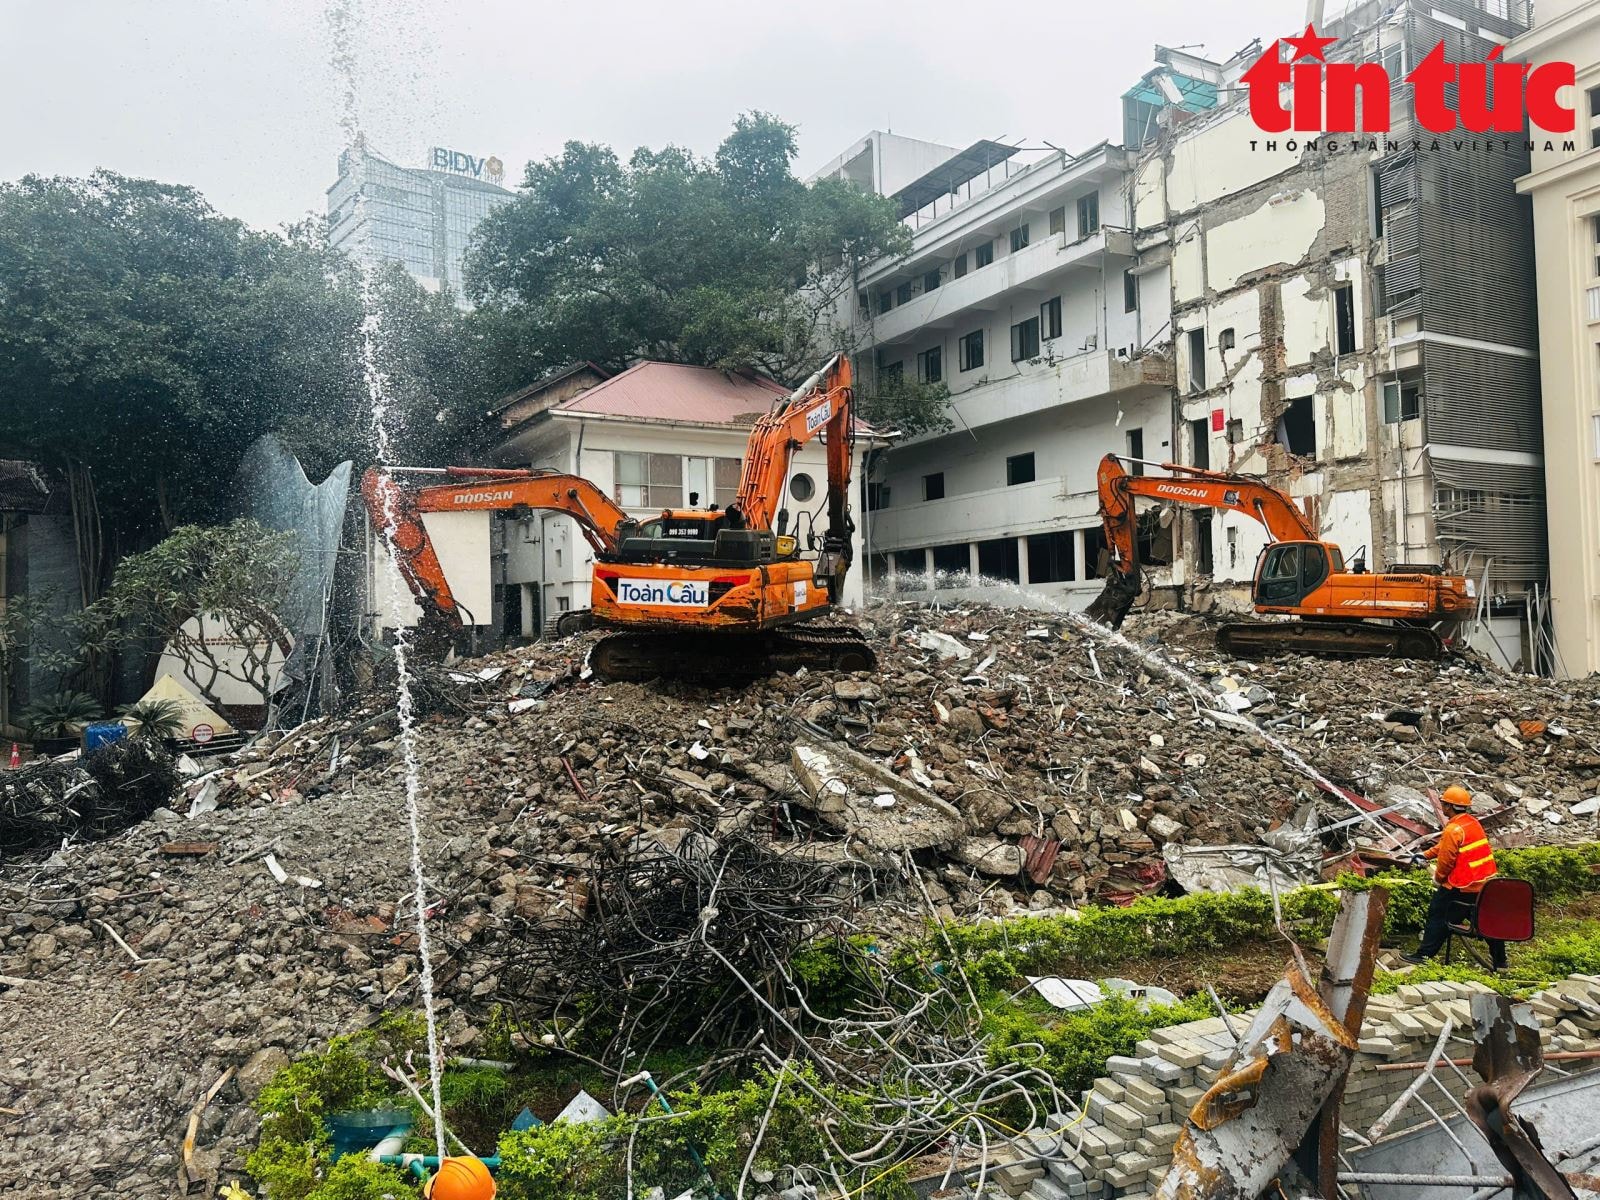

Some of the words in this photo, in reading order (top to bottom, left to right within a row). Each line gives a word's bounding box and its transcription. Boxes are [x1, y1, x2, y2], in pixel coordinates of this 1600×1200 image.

[433, 146, 485, 176] BIDV
[454, 490, 513, 504] DOOSAN
[1156, 484, 1208, 498] DOOSAN
[620, 583, 664, 602] Toàn
[666, 581, 706, 604] Cầu
